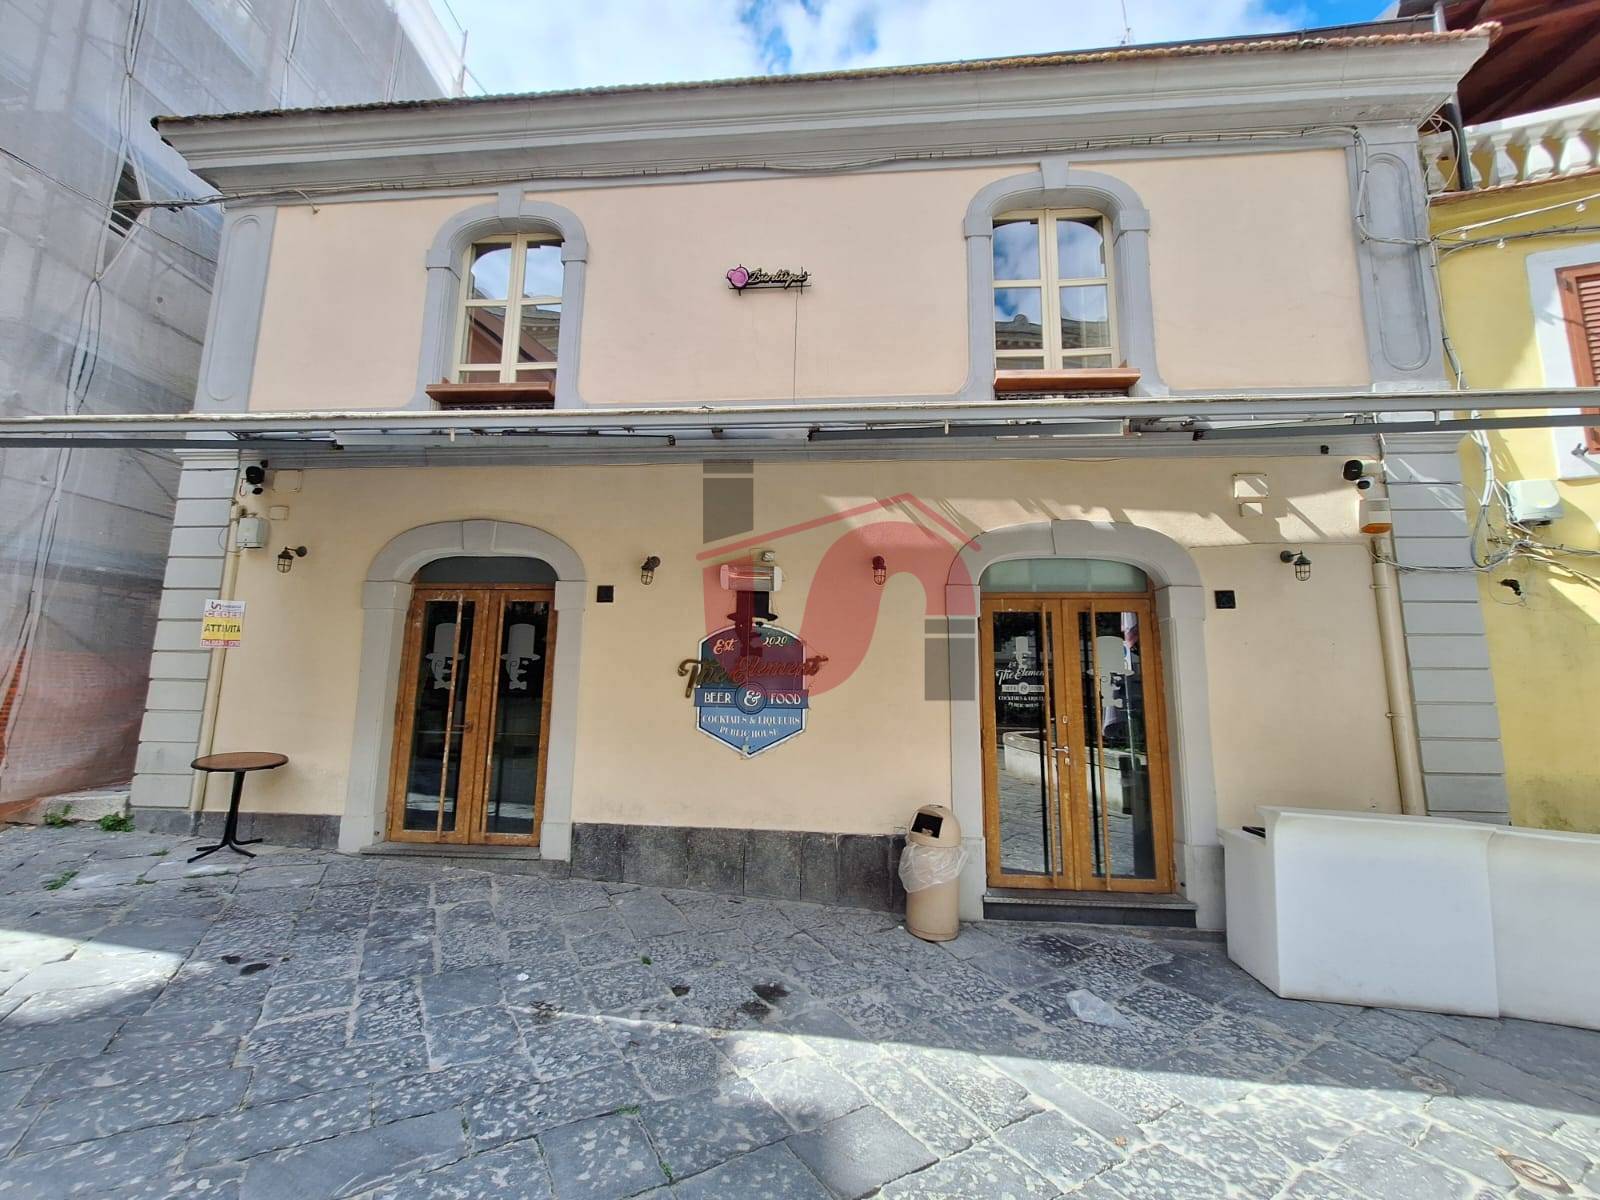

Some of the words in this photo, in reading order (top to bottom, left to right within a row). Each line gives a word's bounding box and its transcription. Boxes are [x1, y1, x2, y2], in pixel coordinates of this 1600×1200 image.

[763, 635, 788, 648] 2020
[677, 658, 728, 698] The
[1015, 668, 1045, 680] Elemen
[704, 692, 732, 704] BEER
[743, 690, 762, 707] &
[770, 693, 801, 705] FOOD
[702, 714, 747, 724] COCKTAILS
[748, 715, 757, 725] &
[758, 715, 800, 726] LIQUEURS
[719, 726, 749, 737] PUBLIC
[751, 728, 777, 738] HOUSE
